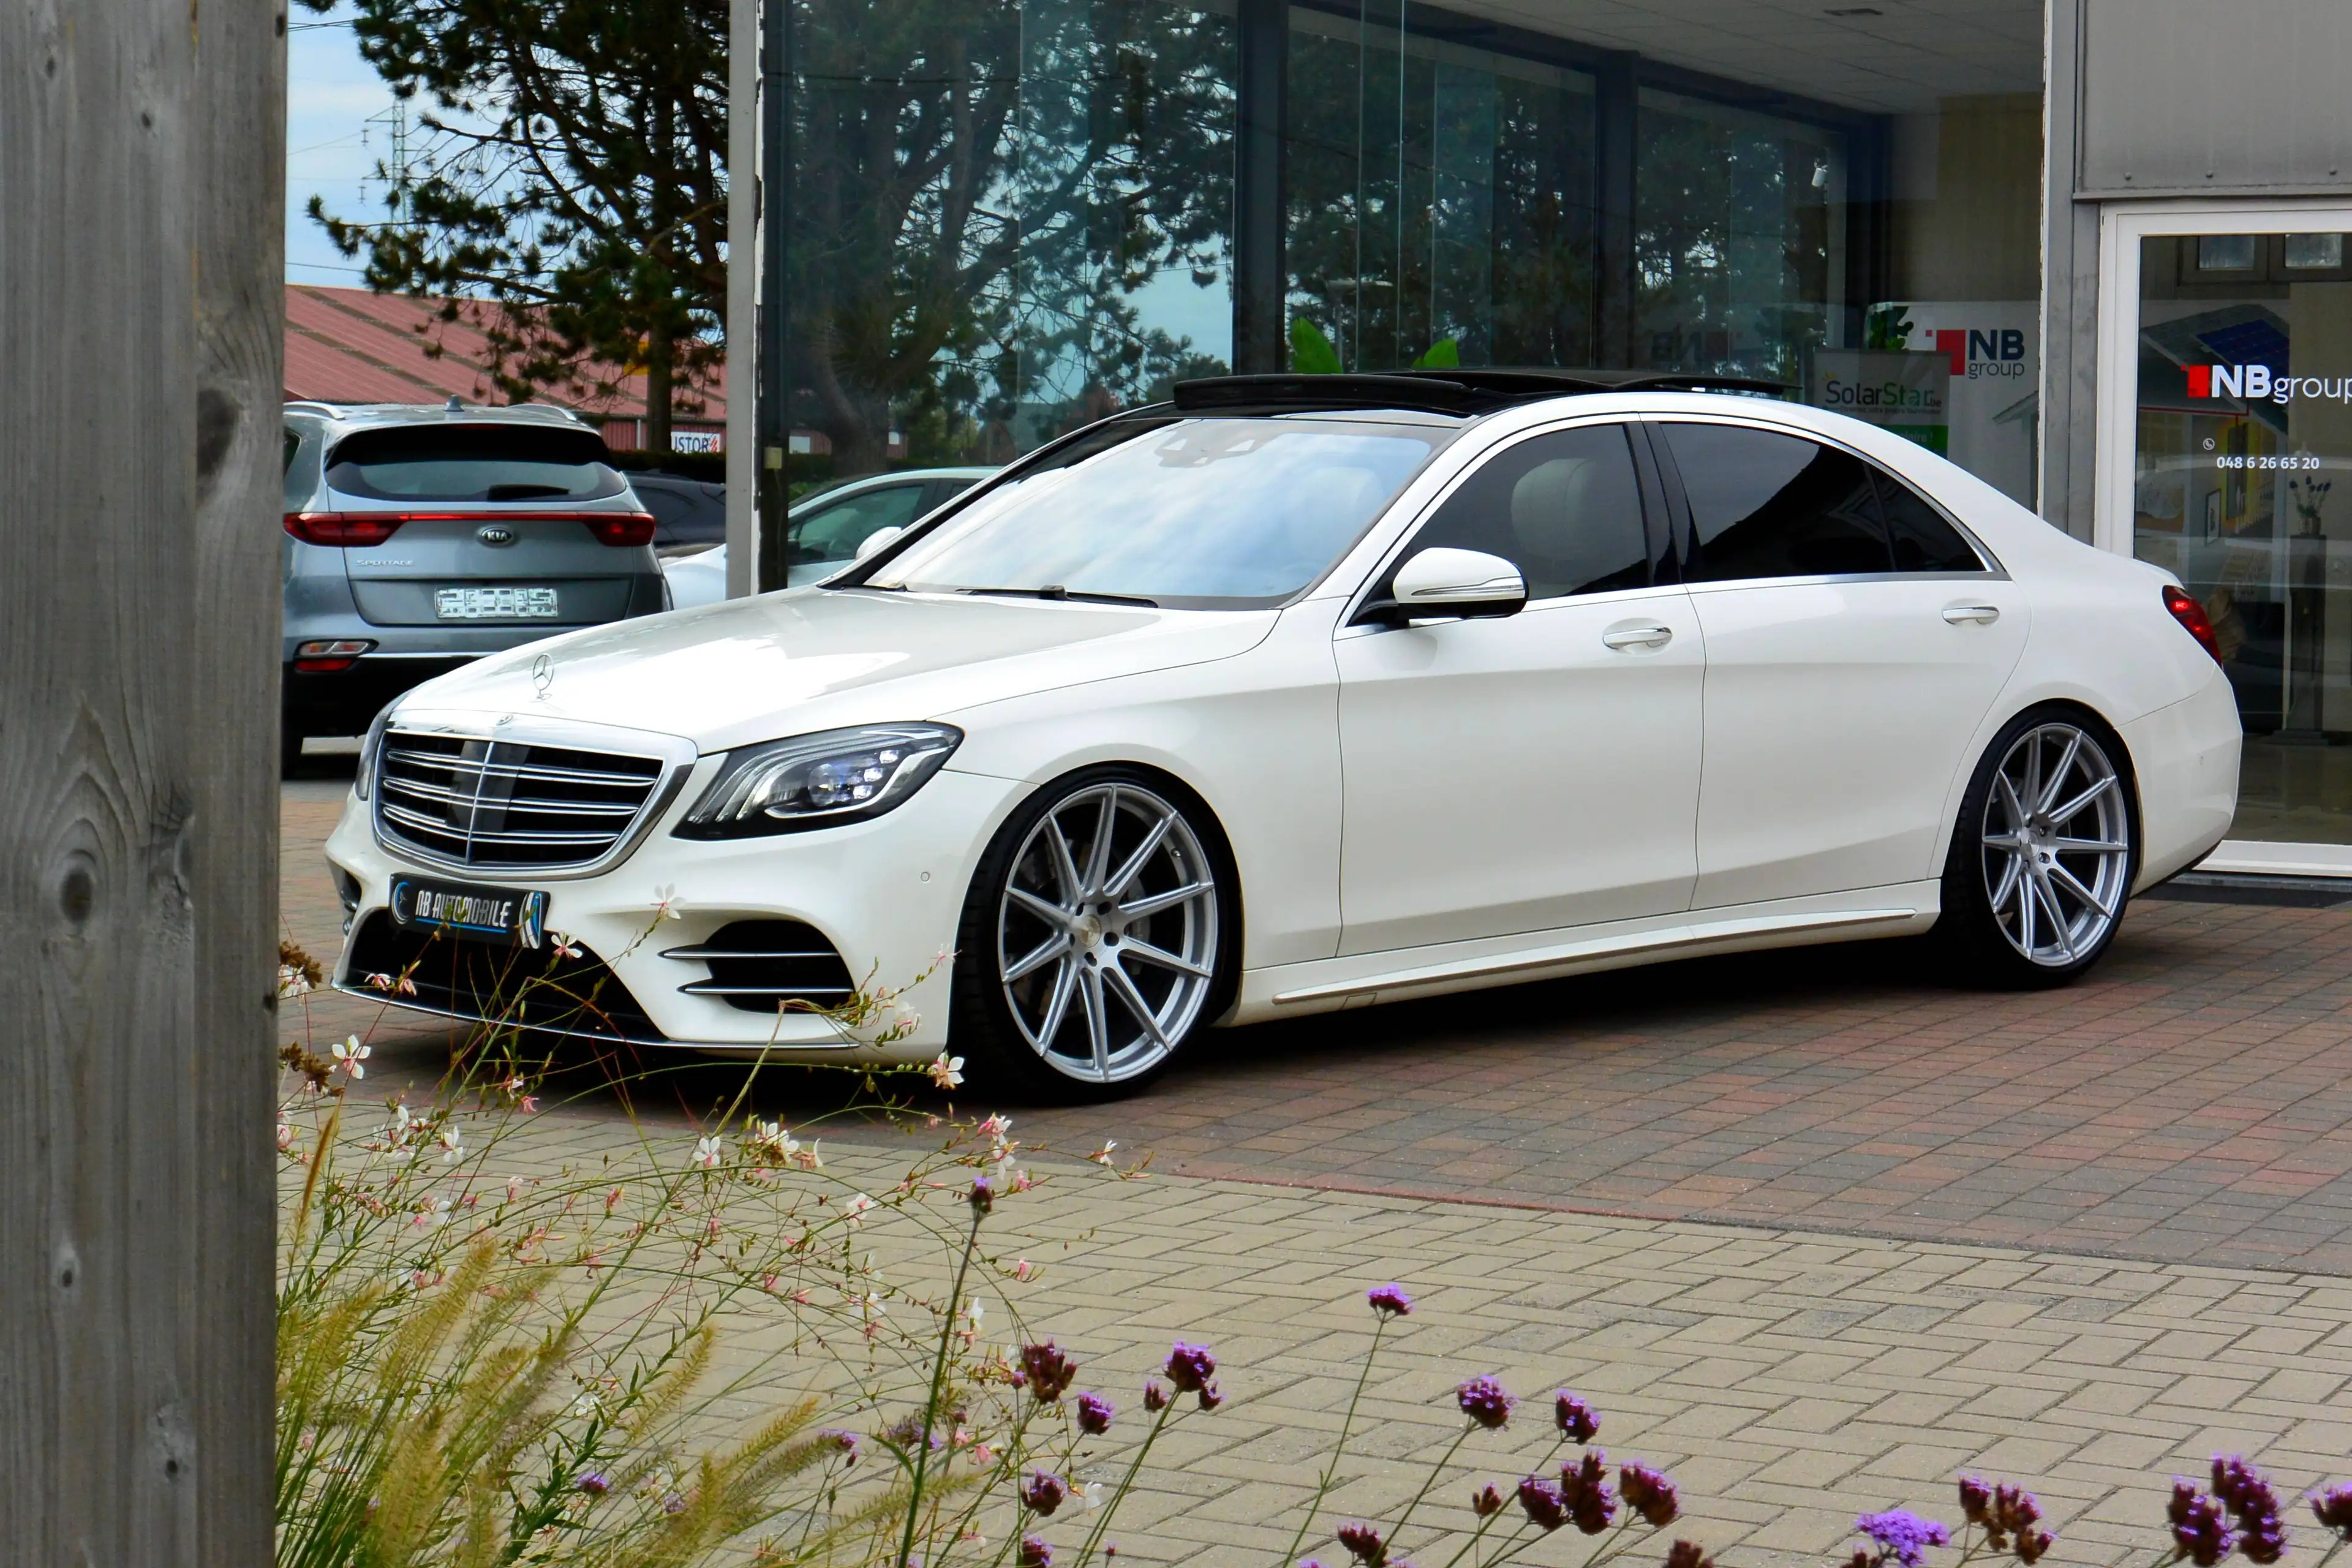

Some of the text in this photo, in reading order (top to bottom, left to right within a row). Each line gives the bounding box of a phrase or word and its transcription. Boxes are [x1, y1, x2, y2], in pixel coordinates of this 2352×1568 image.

[1969, 329, 2025, 360] NB
[1969, 362, 2024, 380] group
[2217, 456, 2320, 470] 048 6 26 65 20
[487, 530, 508, 540] KIA
[432, 892, 512, 928] AUTOMOBILE
